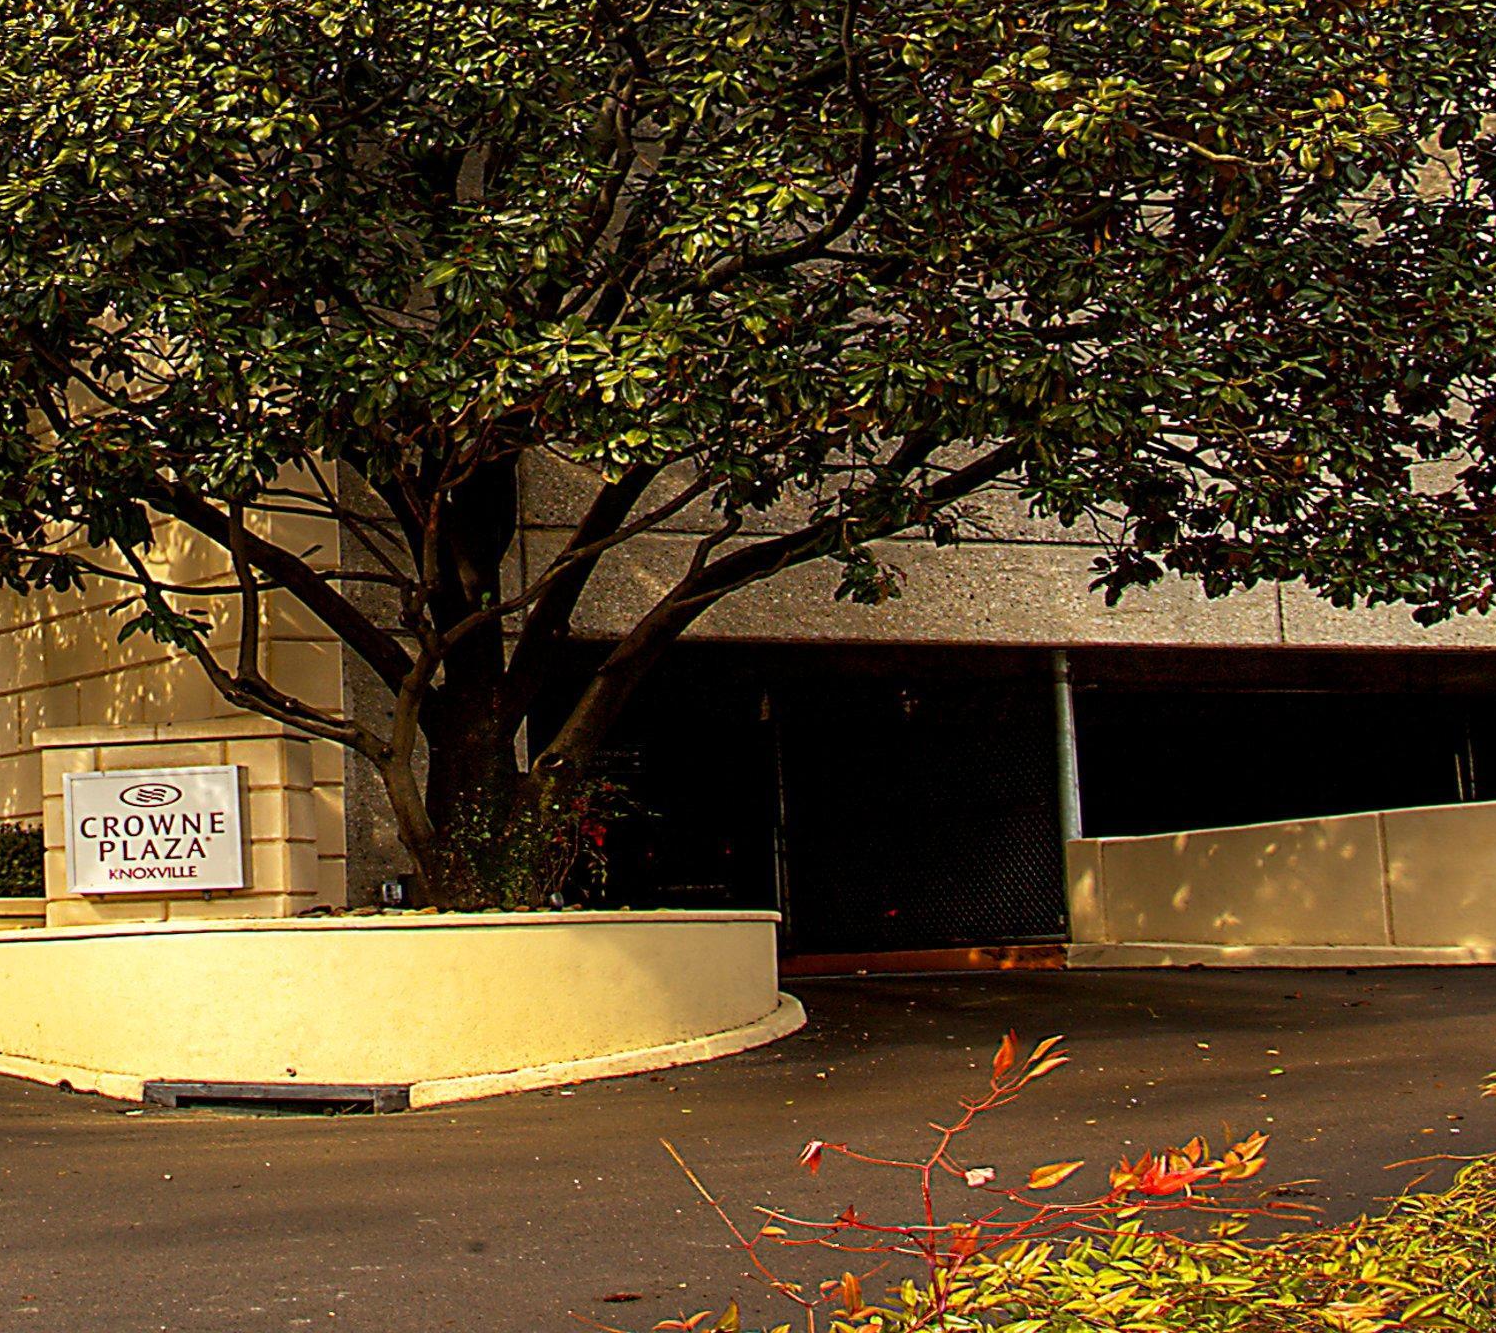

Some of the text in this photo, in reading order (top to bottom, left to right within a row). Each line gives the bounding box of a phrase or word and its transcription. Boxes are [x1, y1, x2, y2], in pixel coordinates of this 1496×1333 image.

[80, 811, 225, 839] CROWNE
[99, 836, 207, 862] PLAZA
[109, 865, 198, 881] KNOXVILLE
